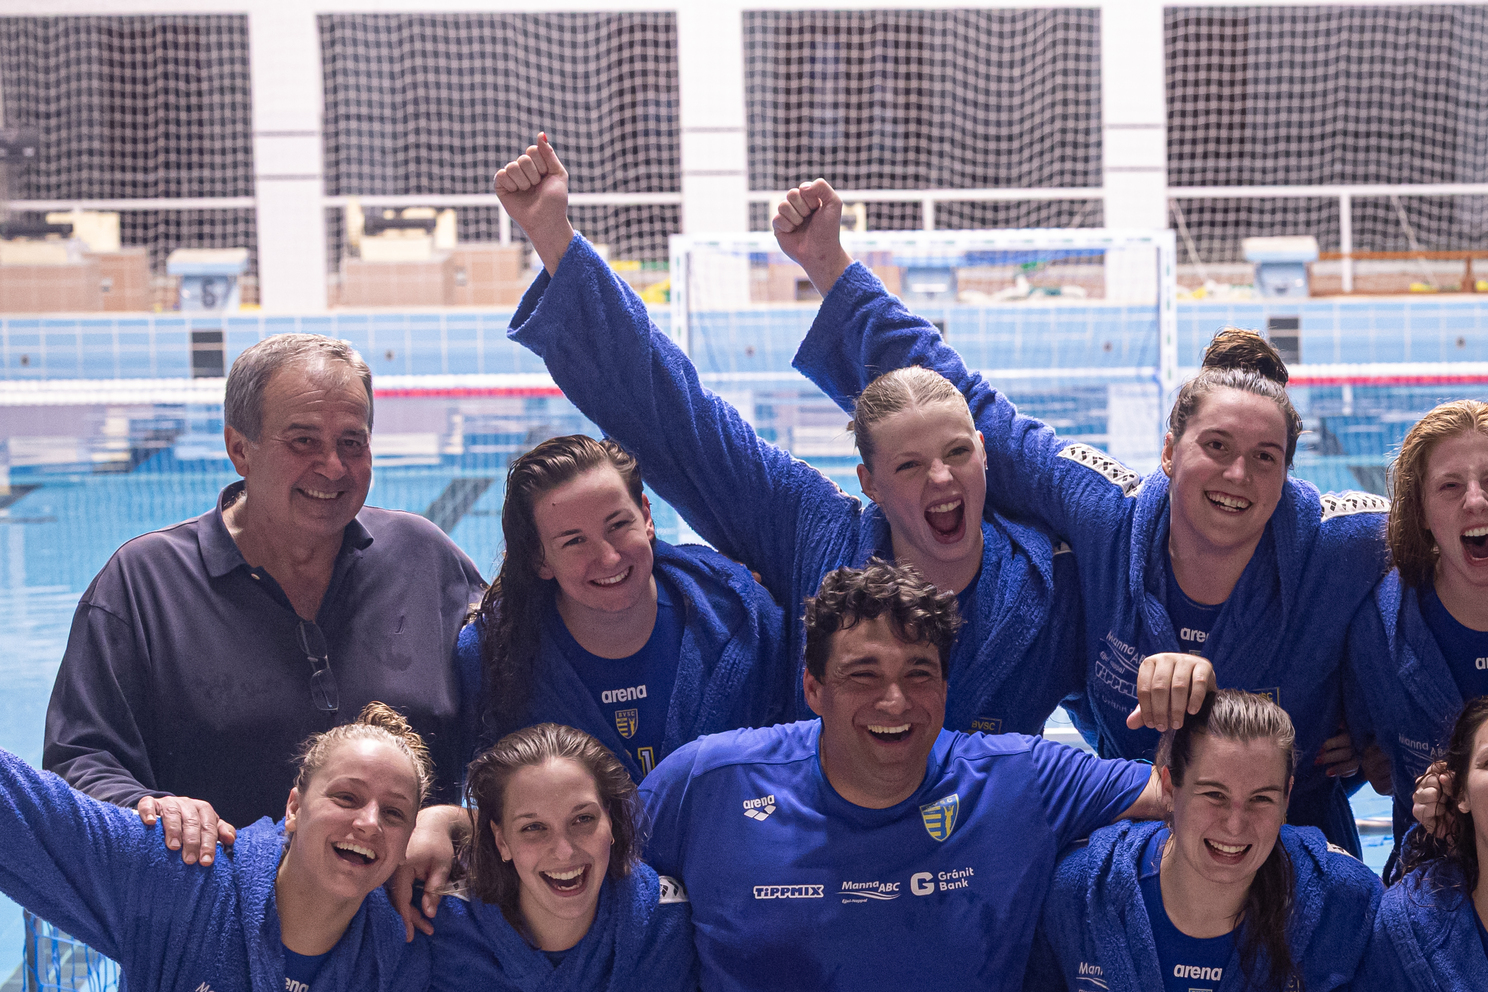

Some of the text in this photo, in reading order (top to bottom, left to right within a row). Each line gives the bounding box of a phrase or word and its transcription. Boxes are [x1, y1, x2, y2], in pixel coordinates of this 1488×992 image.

[1180, 627, 1209, 643] are
[601, 685, 647, 704] arena
[618, 710, 635, 718] BVSC
[971, 720, 996, 731] BVSC
[742, 794, 775, 809] arena
[938, 867, 974, 880] Gránit
[939, 878, 969, 891] Bank
[1079, 962, 1103, 975] Man
[1173, 964, 1223, 981] arena
